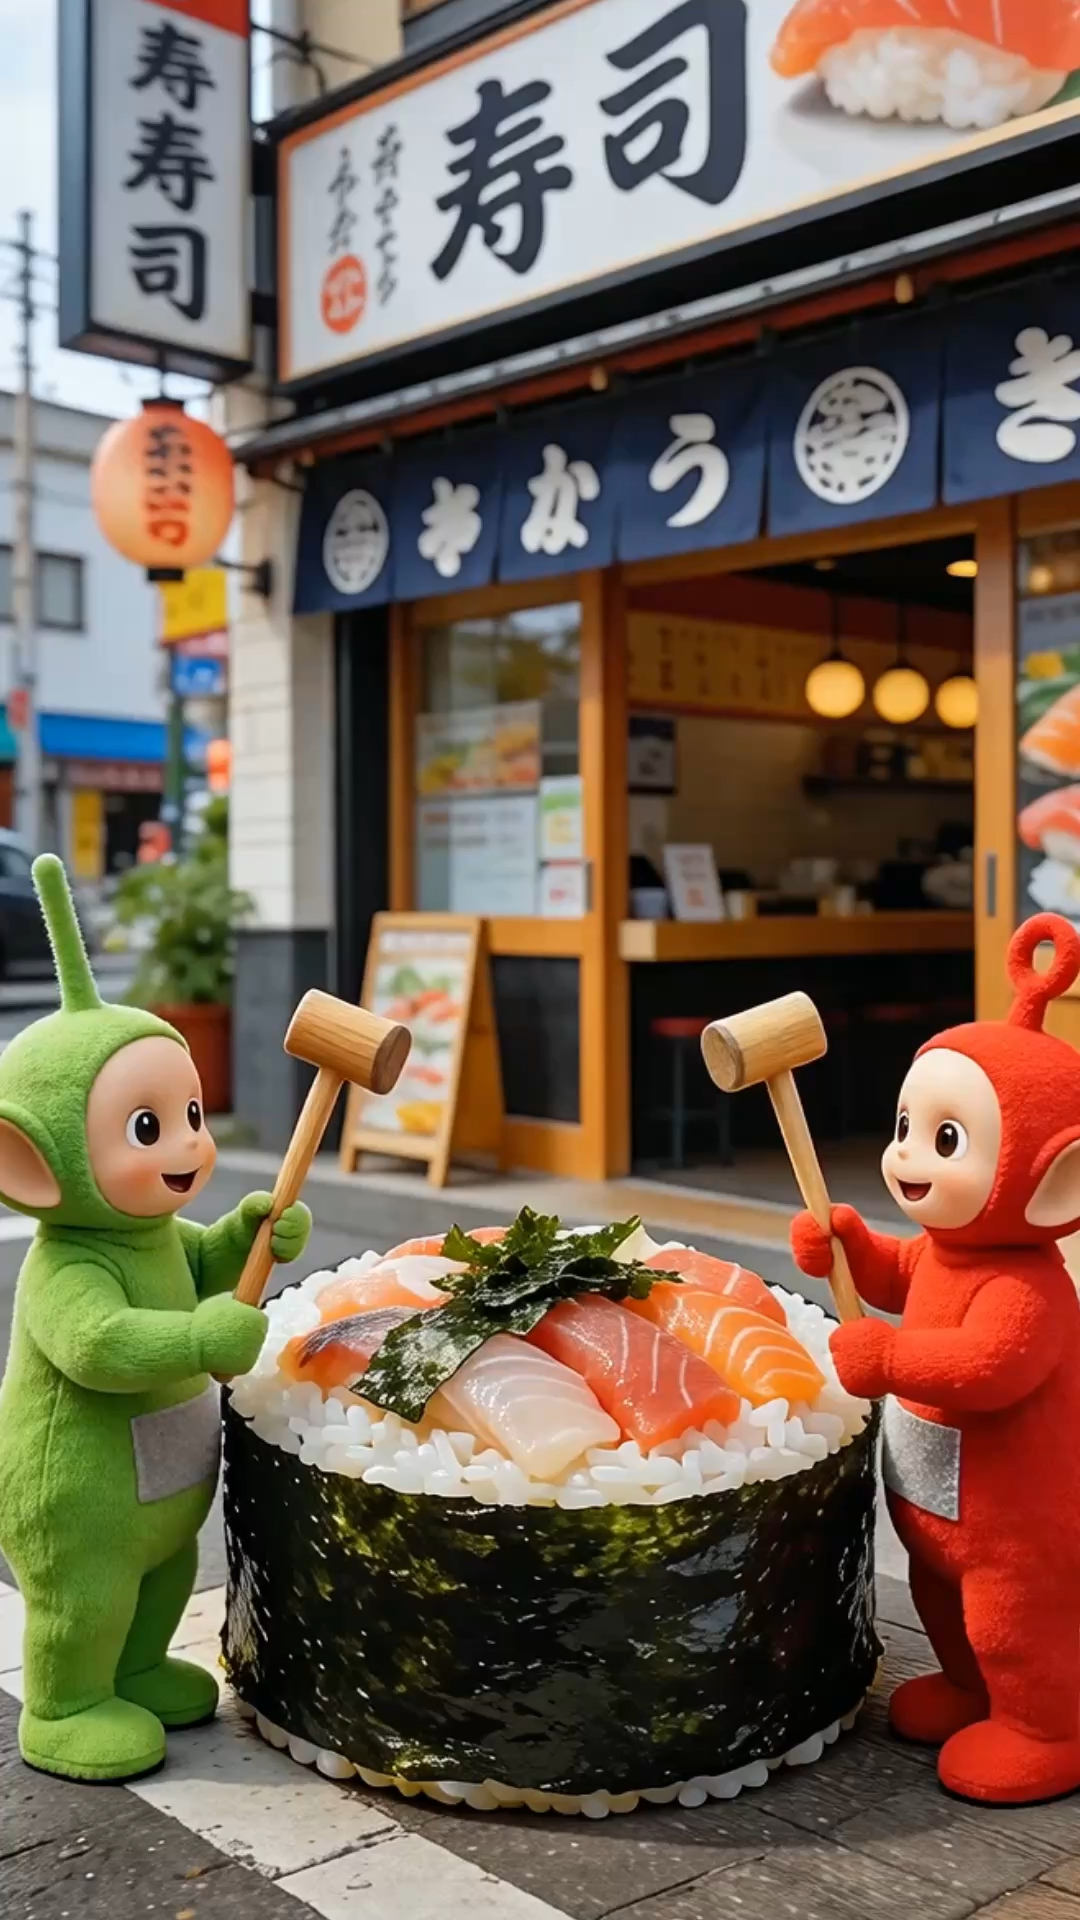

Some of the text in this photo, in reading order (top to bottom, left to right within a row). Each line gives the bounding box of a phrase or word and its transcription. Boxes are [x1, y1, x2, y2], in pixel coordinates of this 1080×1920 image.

[125, 20, 215, 322] 寿寿司
[430, 0, 748, 281] 寿司
